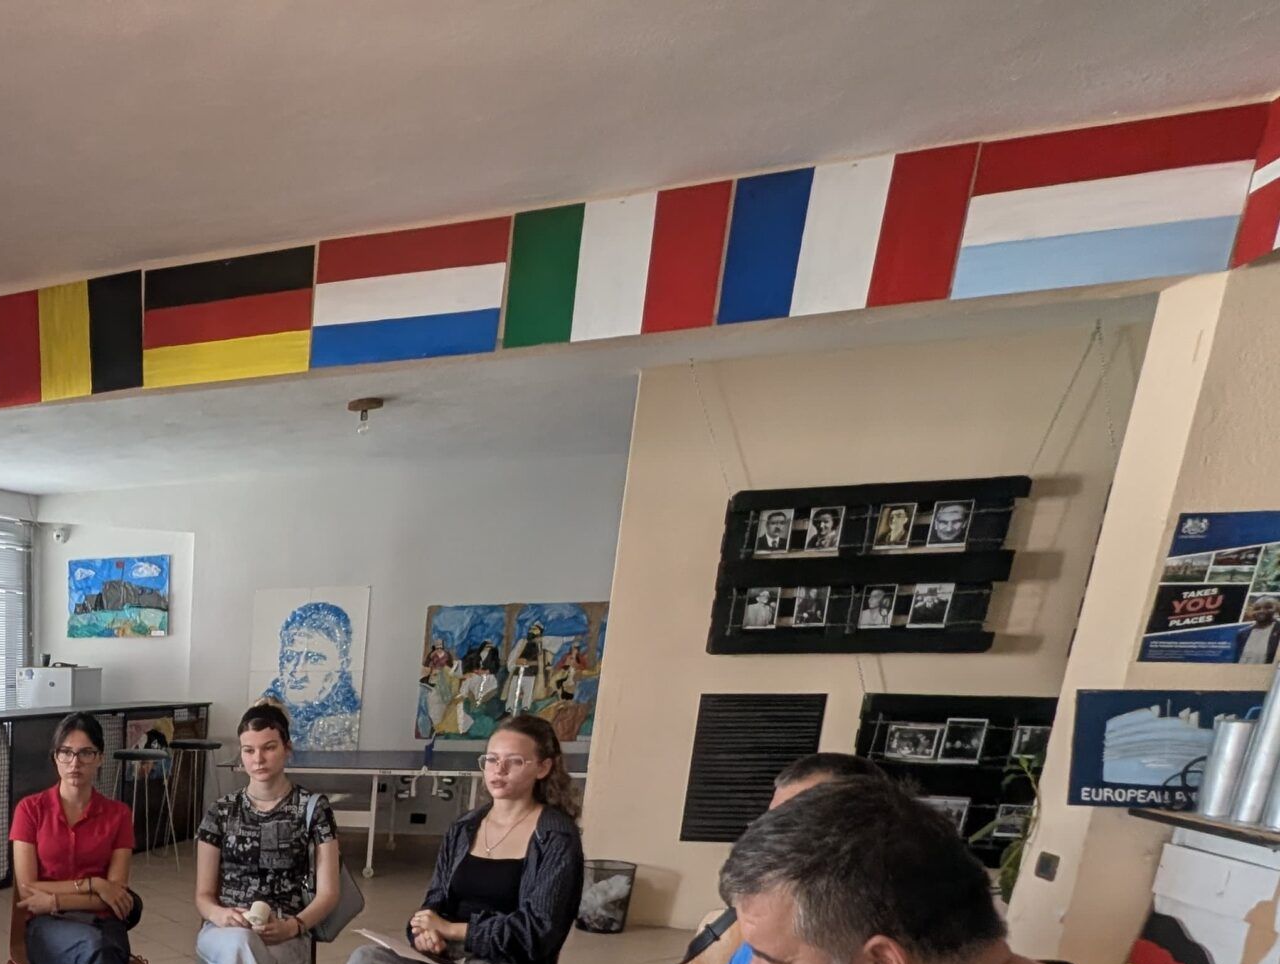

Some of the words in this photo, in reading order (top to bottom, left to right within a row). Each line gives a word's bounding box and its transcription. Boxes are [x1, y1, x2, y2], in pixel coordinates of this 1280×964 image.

[1181, 587, 1219, 599] TAKES
[1171, 594, 1224, 614] YOU
[1168, 614, 1214, 628] PLACES
